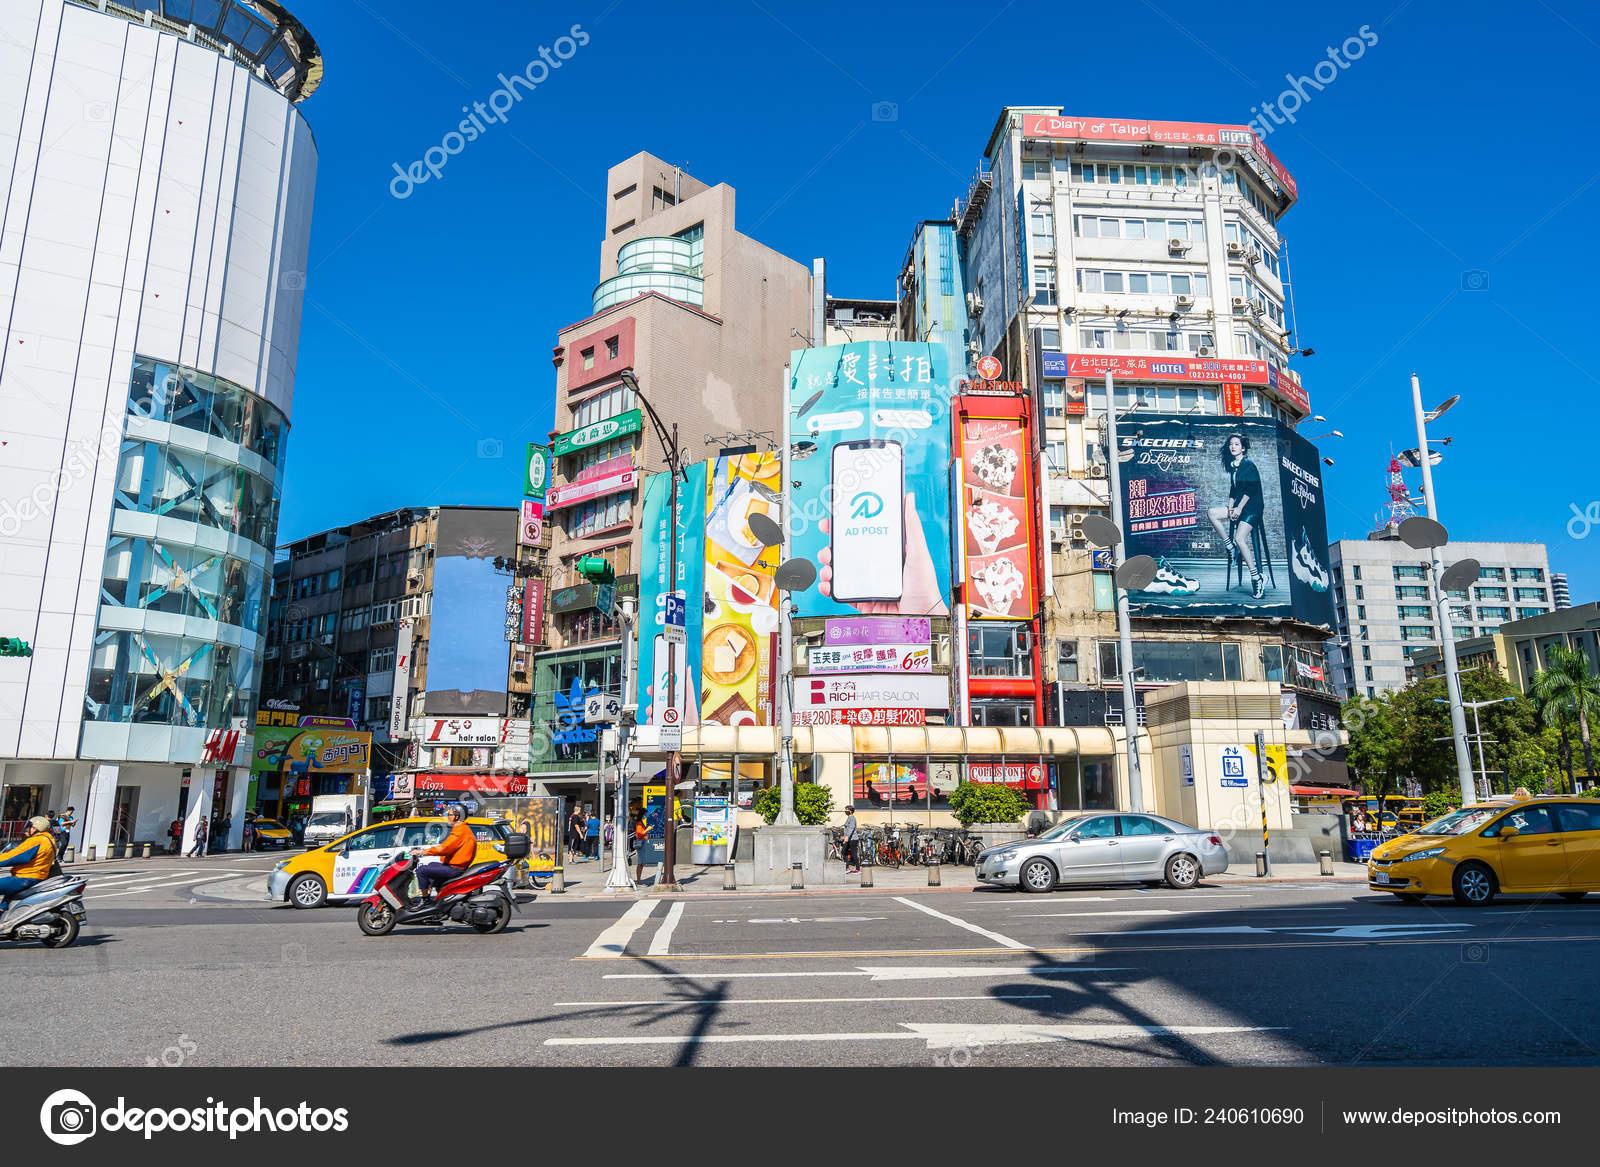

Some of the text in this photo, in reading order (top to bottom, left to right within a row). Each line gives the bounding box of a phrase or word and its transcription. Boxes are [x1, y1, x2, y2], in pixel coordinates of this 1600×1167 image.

[1049, 118, 1151, 136] Diary of Taipei
[1152, 363, 1185, 374] HOTEL
[856, 388, 931, 401] 接廣告更簡單
[1121, 439, 1205, 448] SKECHERS
[1129, 492, 1196, 519] 難以抗拒
[844, 526, 889, 537] AD POST
[812, 651, 841, 664] 玉芙蓉
[852, 648, 897, 663] 按摩 護膚
[902, 652, 929, 671] 699
[829, 691, 920, 702] RICH HAIR SALON
[256, 710, 300, 727] 西門町
[393, 712, 402, 731] salon
[458, 733, 497, 742] hair salon
[199, 727, 240, 763] H&M
